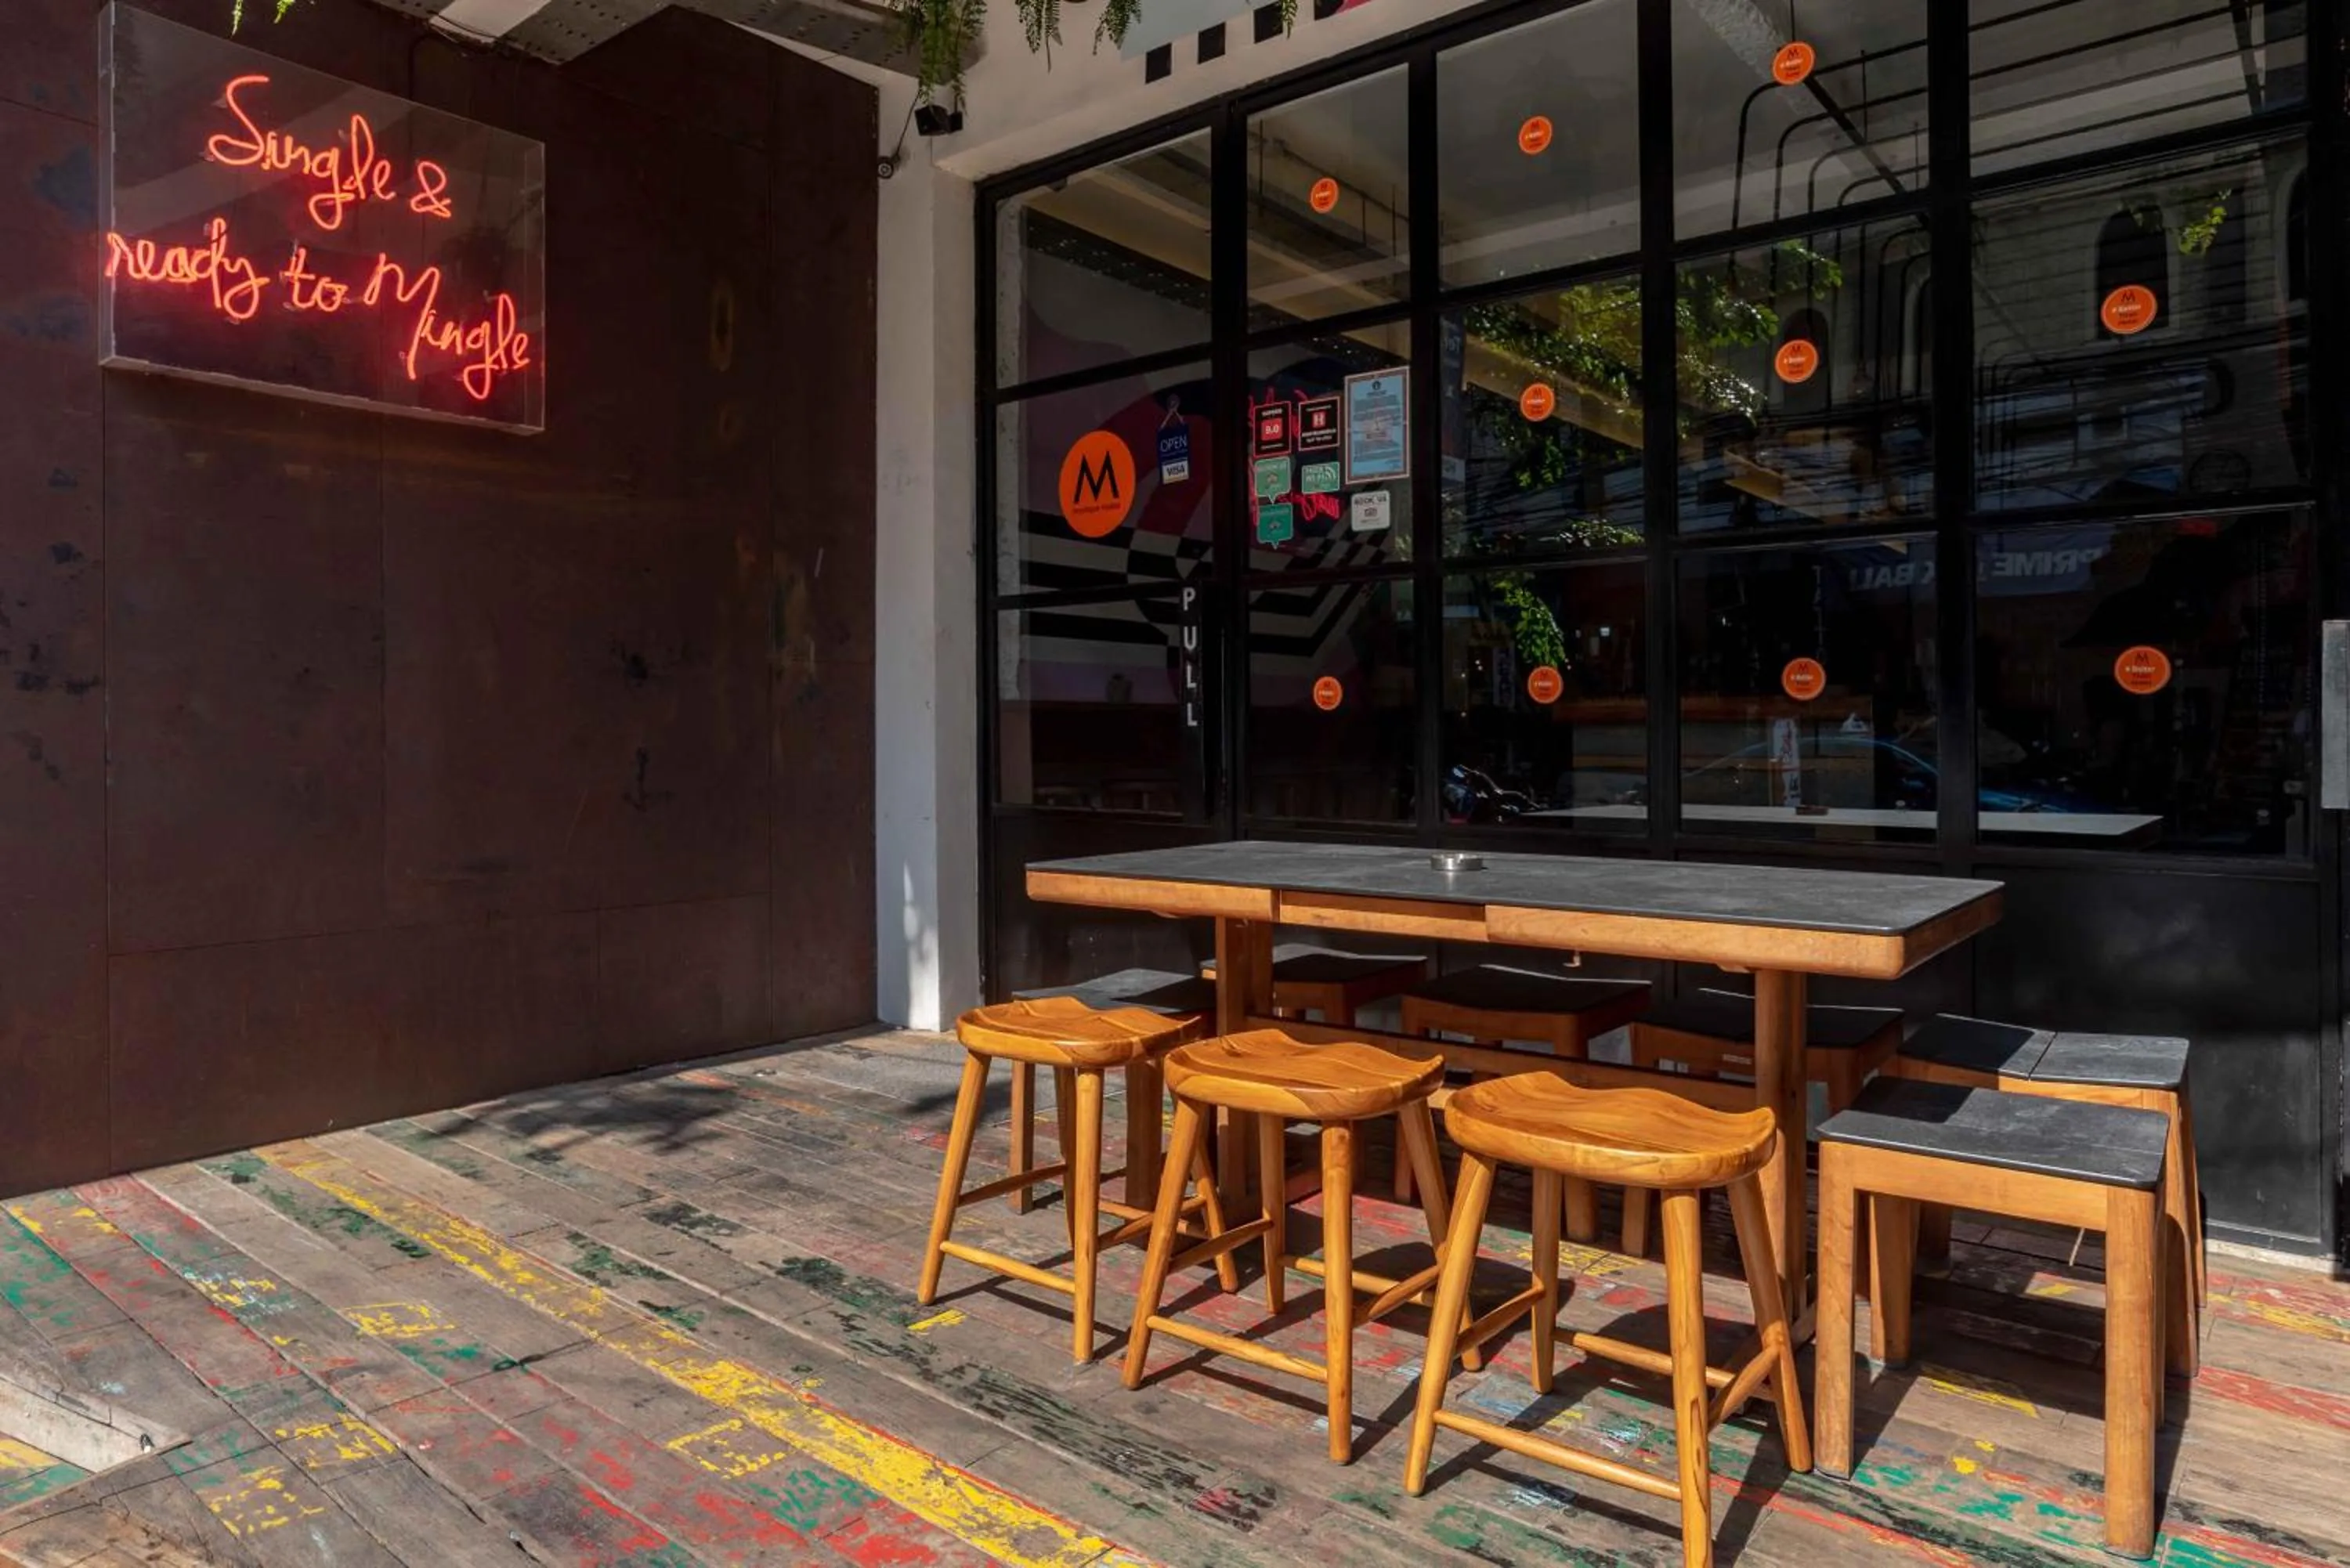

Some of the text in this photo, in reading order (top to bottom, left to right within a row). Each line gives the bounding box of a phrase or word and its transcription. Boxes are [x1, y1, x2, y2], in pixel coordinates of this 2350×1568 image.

[207, 75, 452, 230] Single &
[105, 218, 530, 400] ready to Mingle
[1073, 450, 1119, 504] M
[1160, 434, 1188, 452] OPEN
[1166, 464, 1185, 476] VISA
[1183, 587, 1198, 727] PULL
